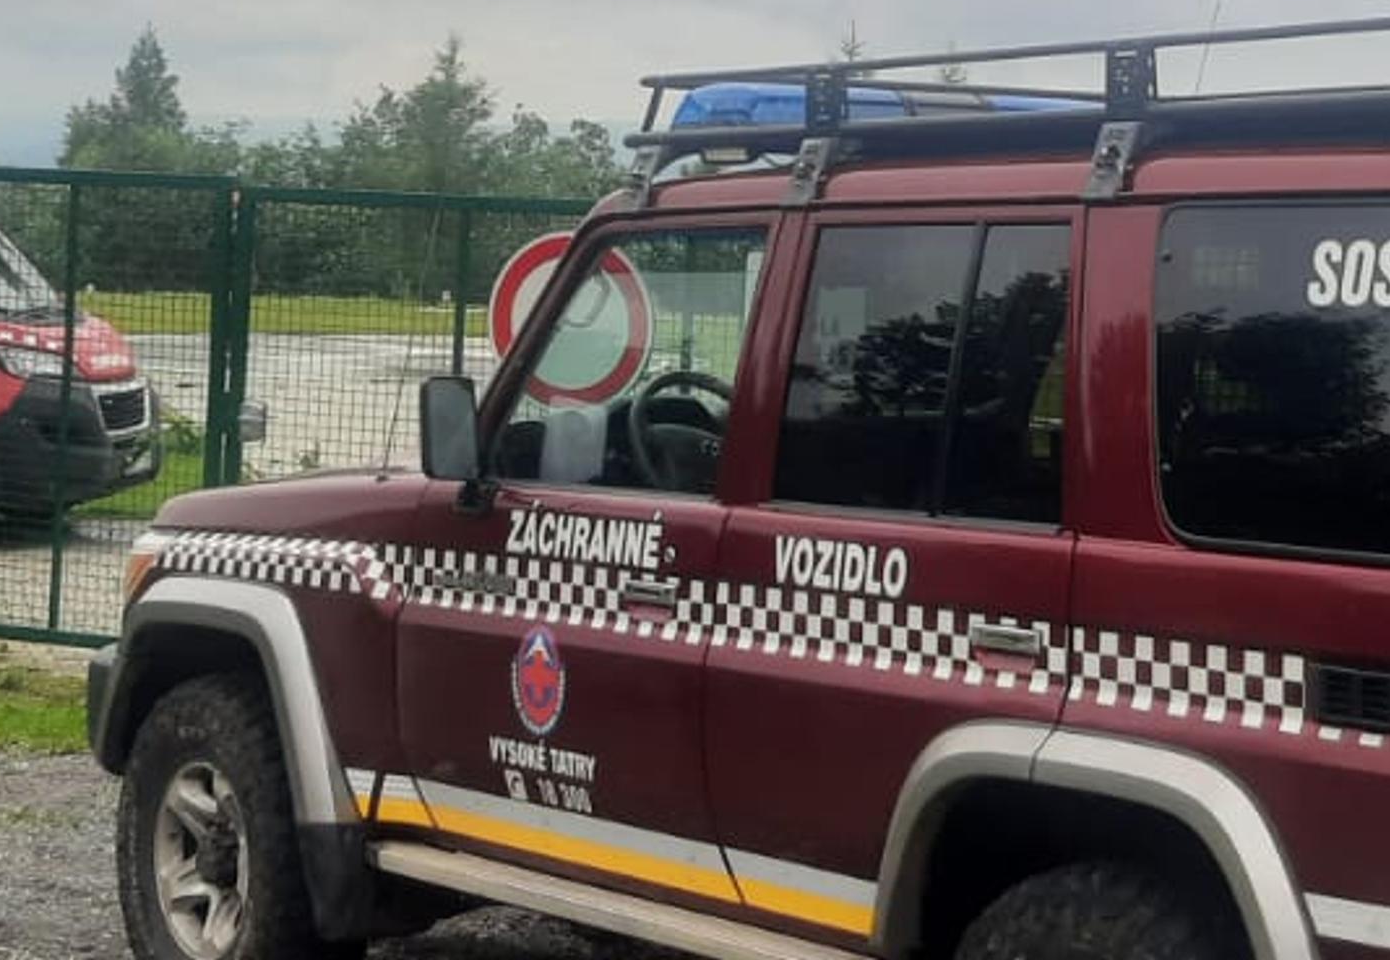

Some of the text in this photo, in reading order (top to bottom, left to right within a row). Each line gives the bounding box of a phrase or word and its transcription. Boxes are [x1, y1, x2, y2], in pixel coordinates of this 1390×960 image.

[507, 500, 909, 599] ZÁCHRANNÉ VOZIDLO
[489, 736, 596, 782] VYSOKÉ TATRY
